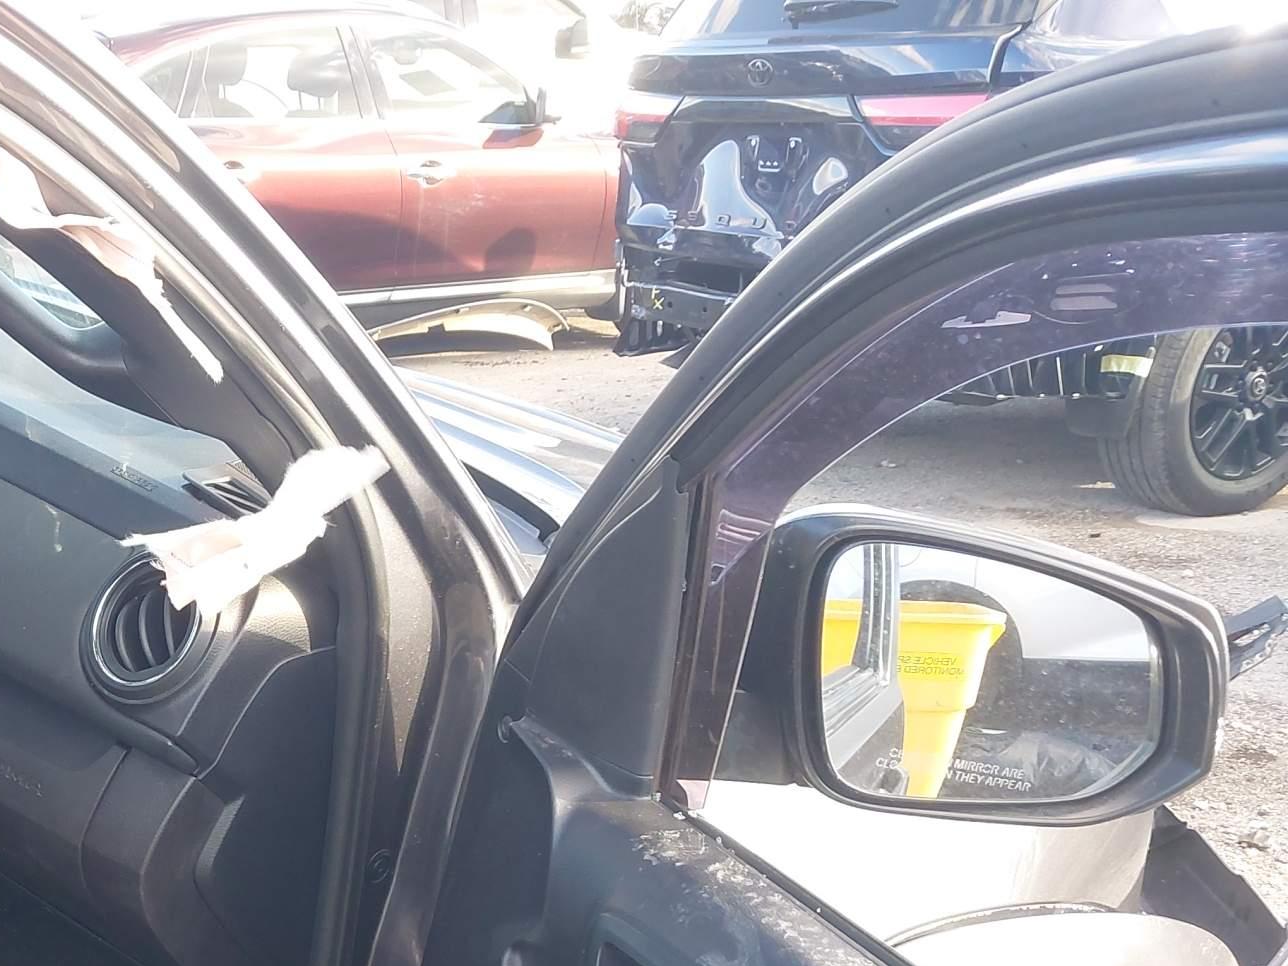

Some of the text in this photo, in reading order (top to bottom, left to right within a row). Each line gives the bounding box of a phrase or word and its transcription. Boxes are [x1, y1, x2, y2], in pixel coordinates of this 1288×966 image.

[953, 758, 1025, 780] MIRROR ARE
[955, 770, 986, 785] THEY
[985, 776, 1032, 793] APPEAR
